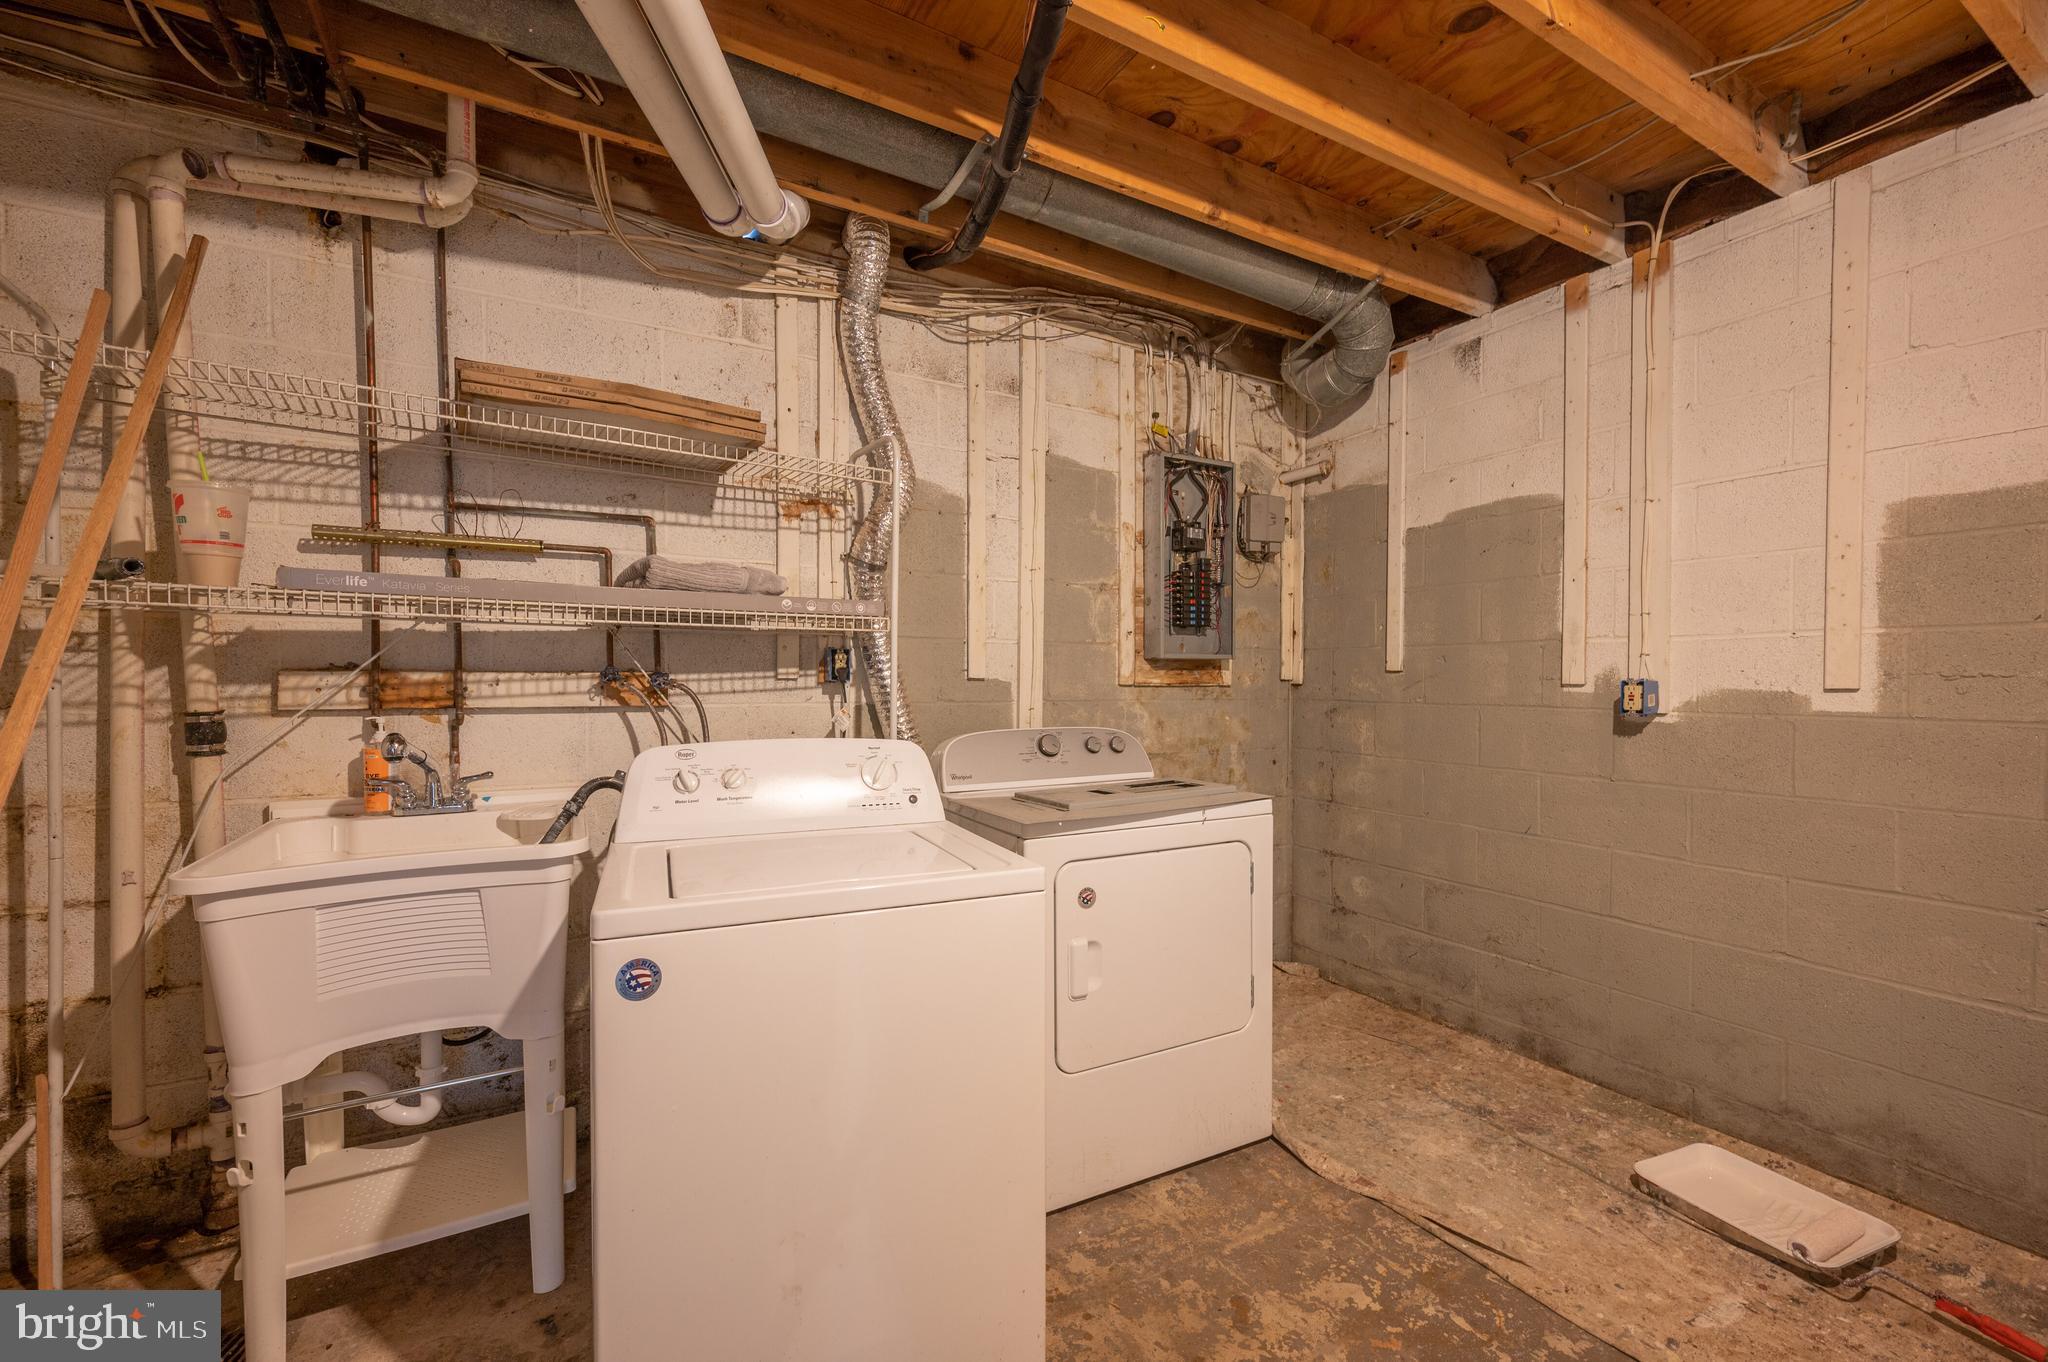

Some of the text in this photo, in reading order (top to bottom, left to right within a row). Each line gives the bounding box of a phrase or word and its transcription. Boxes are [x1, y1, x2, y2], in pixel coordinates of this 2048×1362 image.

[435, 581, 471, 593] Series
[677, 750, 695, 759] Roper
[949, 773, 973, 781] Whirlpool
[620, 959, 660, 977] AMERICA
